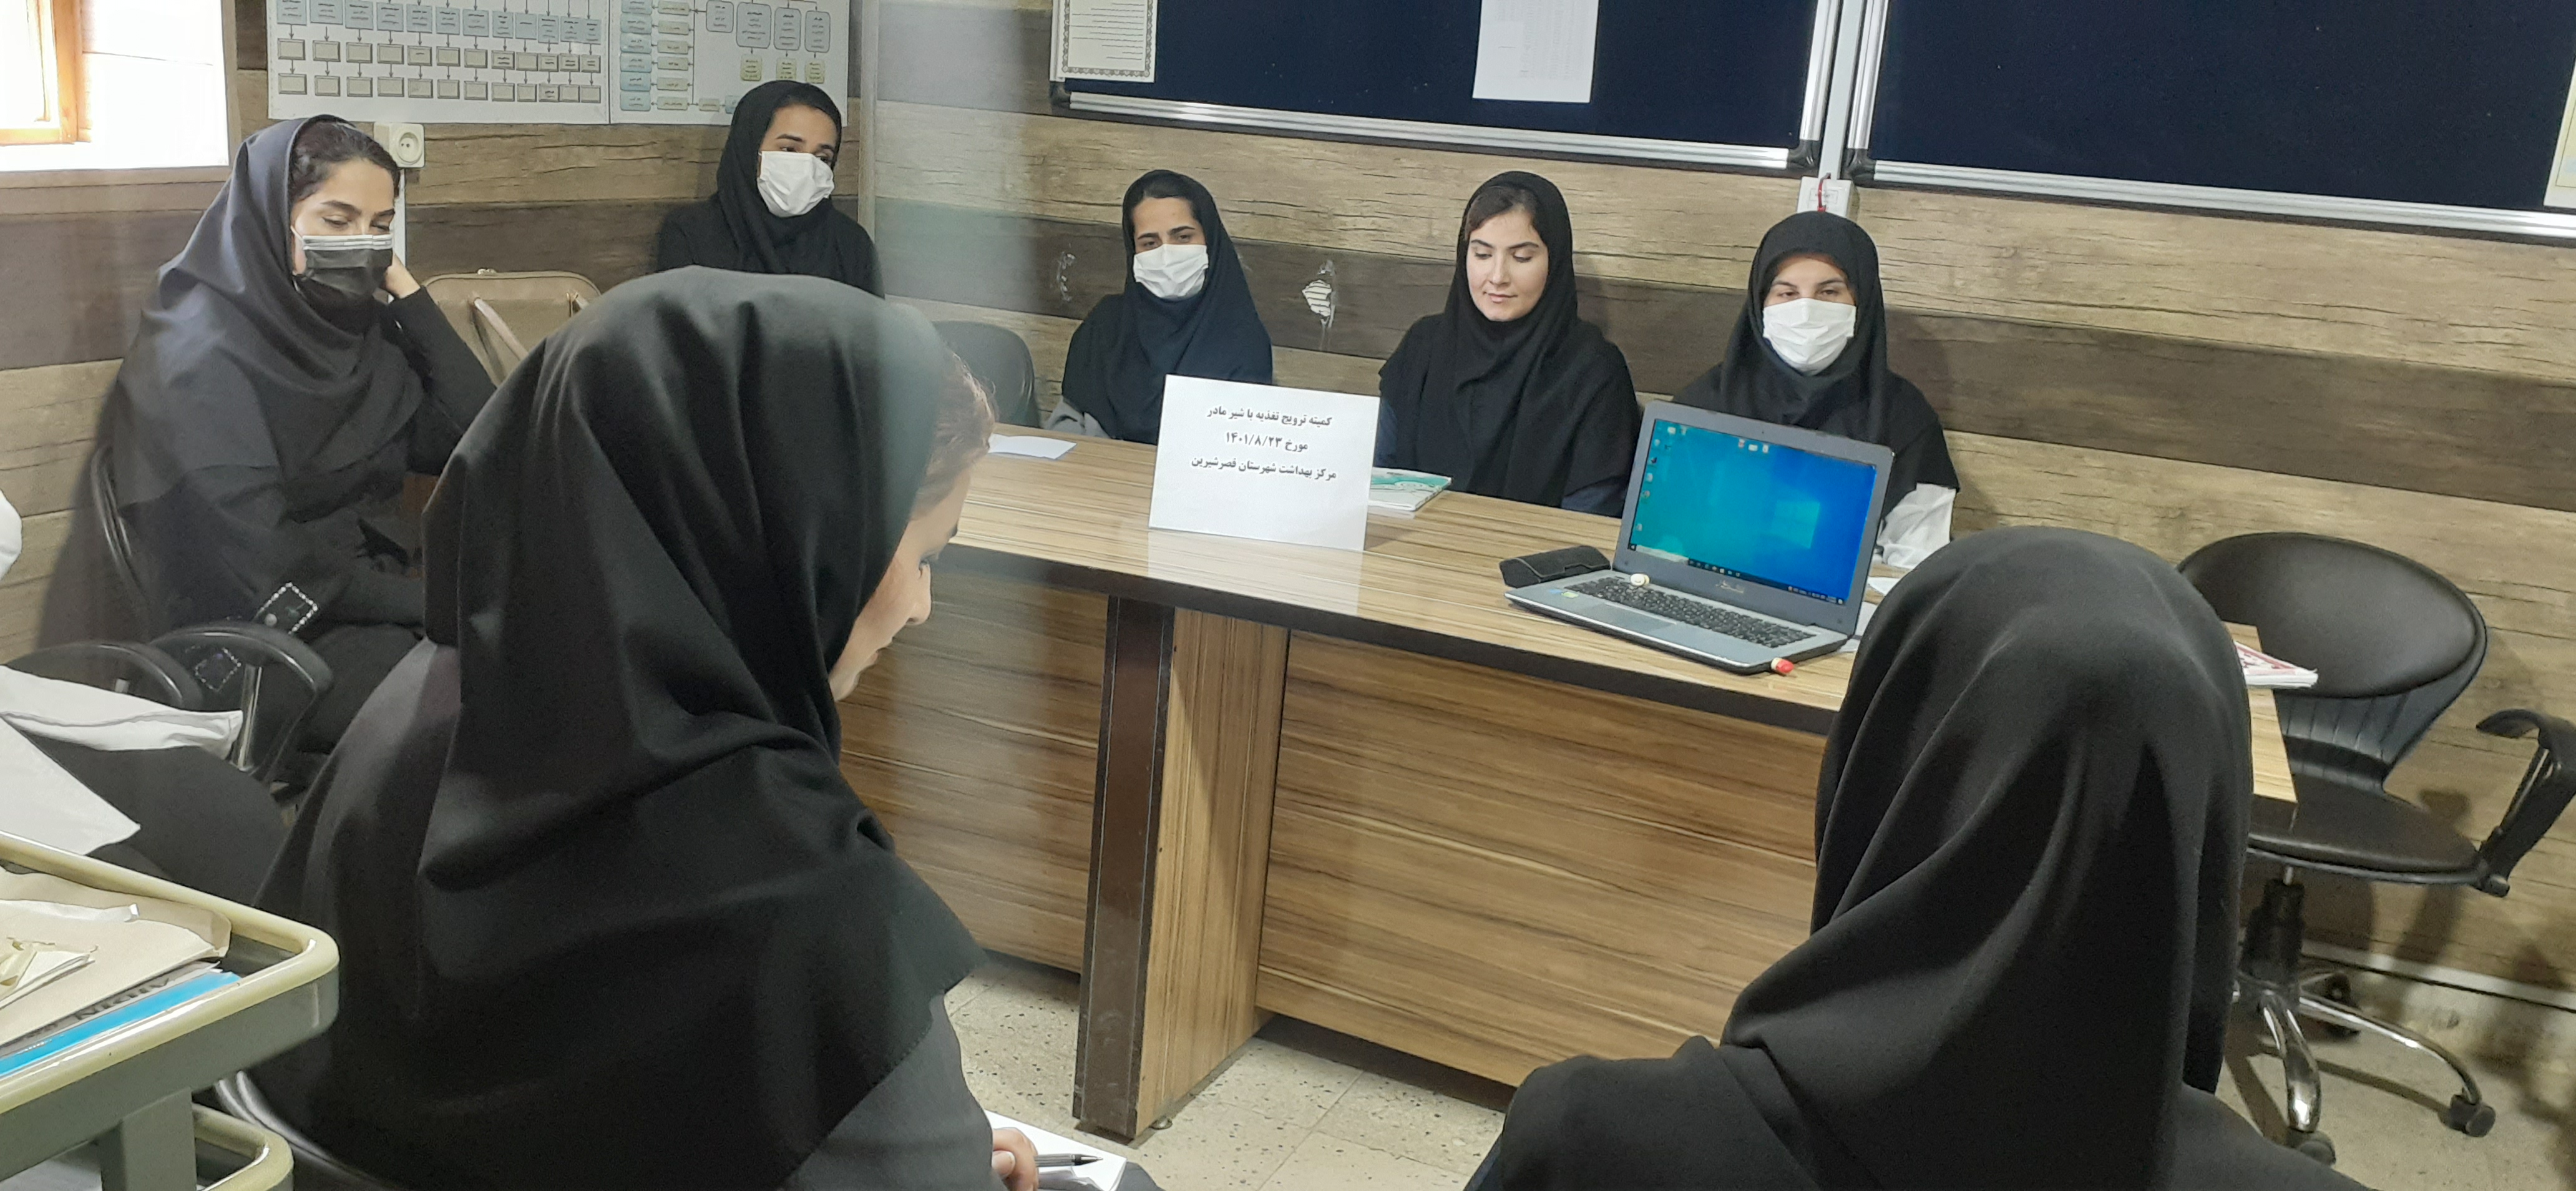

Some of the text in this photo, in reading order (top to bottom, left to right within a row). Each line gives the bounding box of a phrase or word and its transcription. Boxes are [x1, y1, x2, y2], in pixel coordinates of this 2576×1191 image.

[1206, 405, 1332, 428] کمیته ترویج تغذیه با شیر مادر
[1226, 431, 1308, 453] مورخ ۱۴۰۱/۸/۲۳
[1238, 460, 1277, 474] شهرستان
[1279, 464, 1312, 479] بهداشت
[1314, 468, 1337, 481] مرکز
